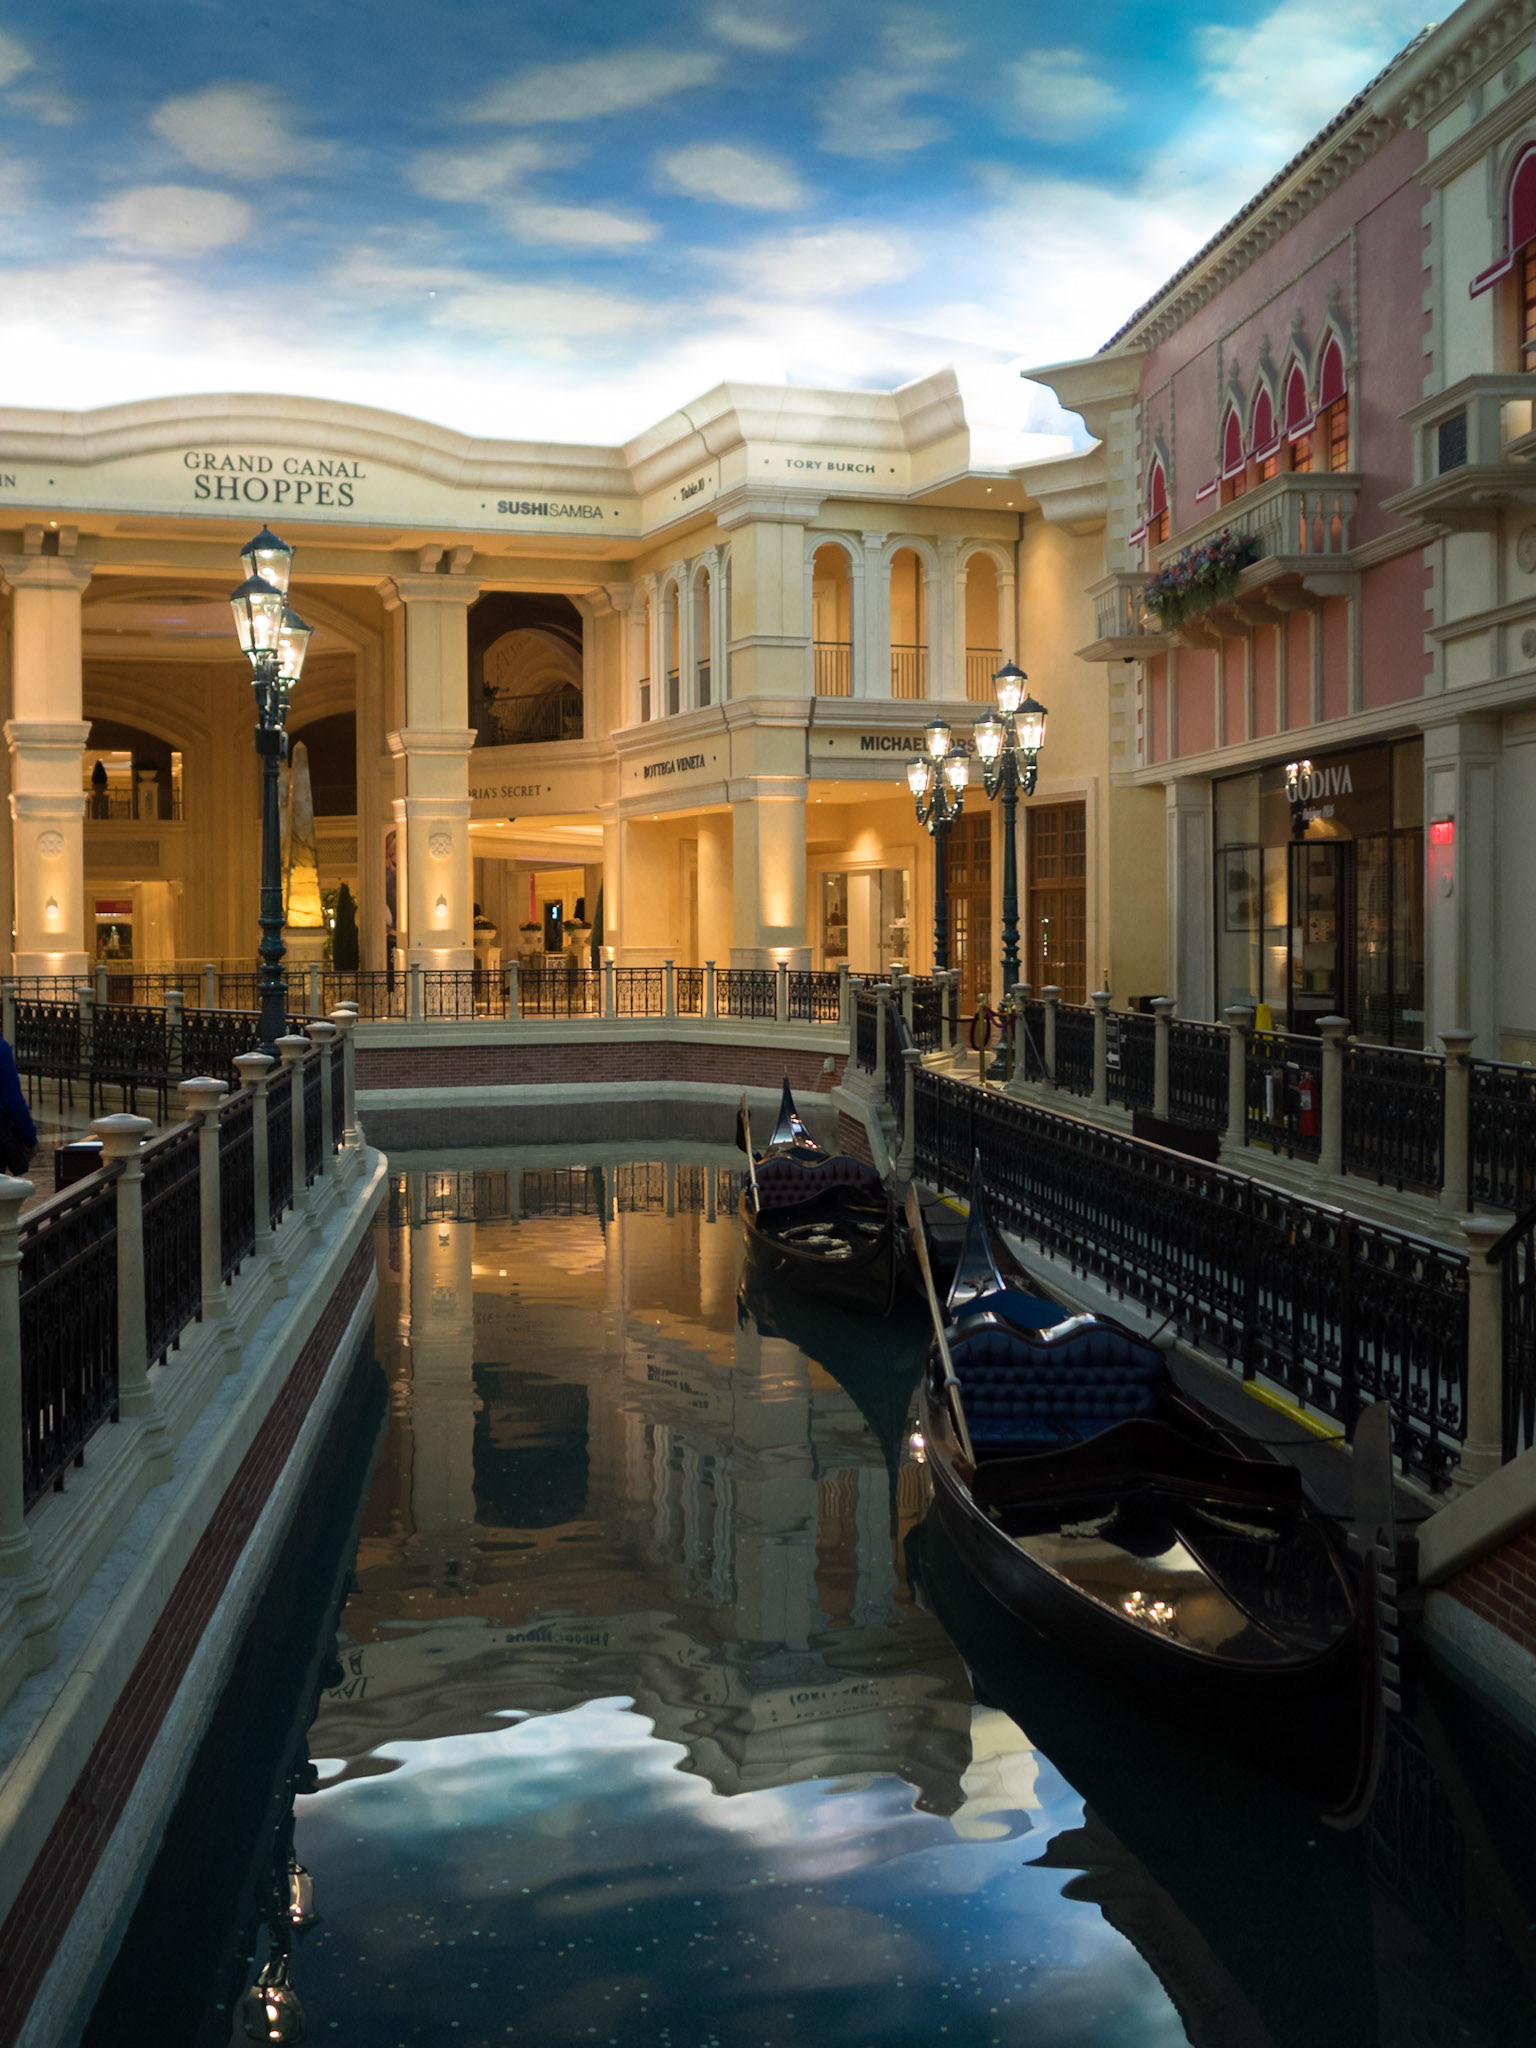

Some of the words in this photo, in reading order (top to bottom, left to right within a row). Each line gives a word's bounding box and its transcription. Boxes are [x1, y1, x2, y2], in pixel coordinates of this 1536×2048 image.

[183, 451, 273, 473] GRAND
[283, 457, 366, 479] CANAL
[785, 458, 822, 471] TORY
[827, 461, 875, 474] BURCH
[194, 474, 354, 507] SHOPPES
[497, 500, 603, 519] SUSHISAMBA
[860, 735, 928, 752] MICHAEL
[643, 760, 675, 779] BOTTEGA
[676, 753, 705, 772] VENETA
[500, 784, 541, 798] SECRET
